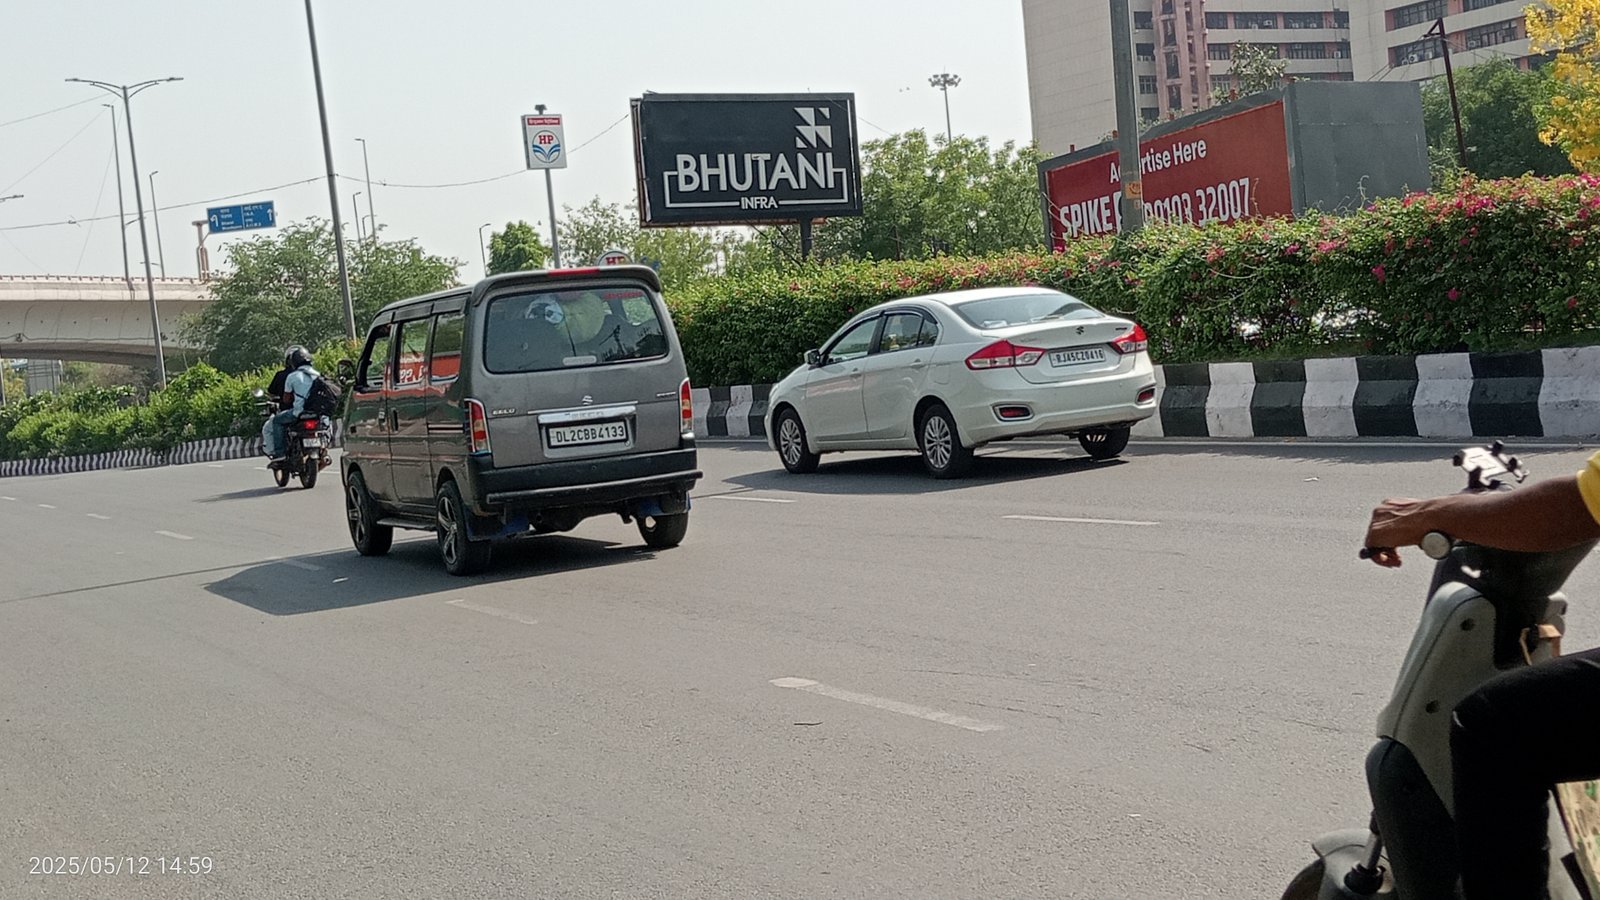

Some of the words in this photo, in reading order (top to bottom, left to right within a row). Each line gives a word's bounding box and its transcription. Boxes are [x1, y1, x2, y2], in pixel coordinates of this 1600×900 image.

[538, 134, 554, 145] HP
[676, 152, 835, 192] BHUTANI
[1110, 147, 1171, 184] Artise
[1172, 139, 1207, 166] Here
[741, 196, 779, 210] INFRA
[1060, 195, 1113, 242] SPIKE
[1195, 177, 1250, 228] 32007
[556, 425, 625, 443] DL2CBB4133
